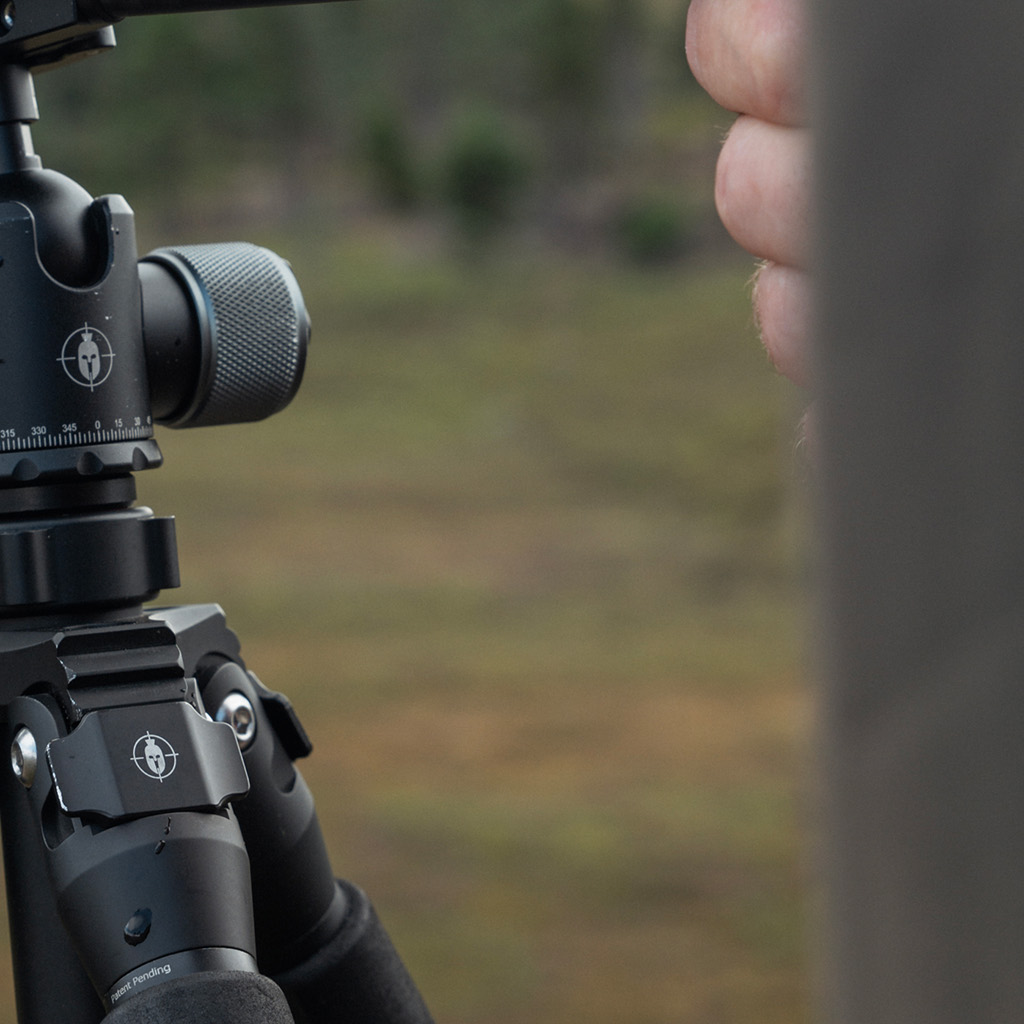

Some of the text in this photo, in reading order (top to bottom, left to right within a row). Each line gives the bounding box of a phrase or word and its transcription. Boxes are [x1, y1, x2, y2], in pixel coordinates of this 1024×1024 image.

[0, 429, 16, 439] 315
[31, 426, 47, 436] 330
[62, 423, 78, 433] 345
[94, 420, 101, 430] 0
[115, 418, 123, 428] 15
[110, 963, 172, 1005] Patent Pending
